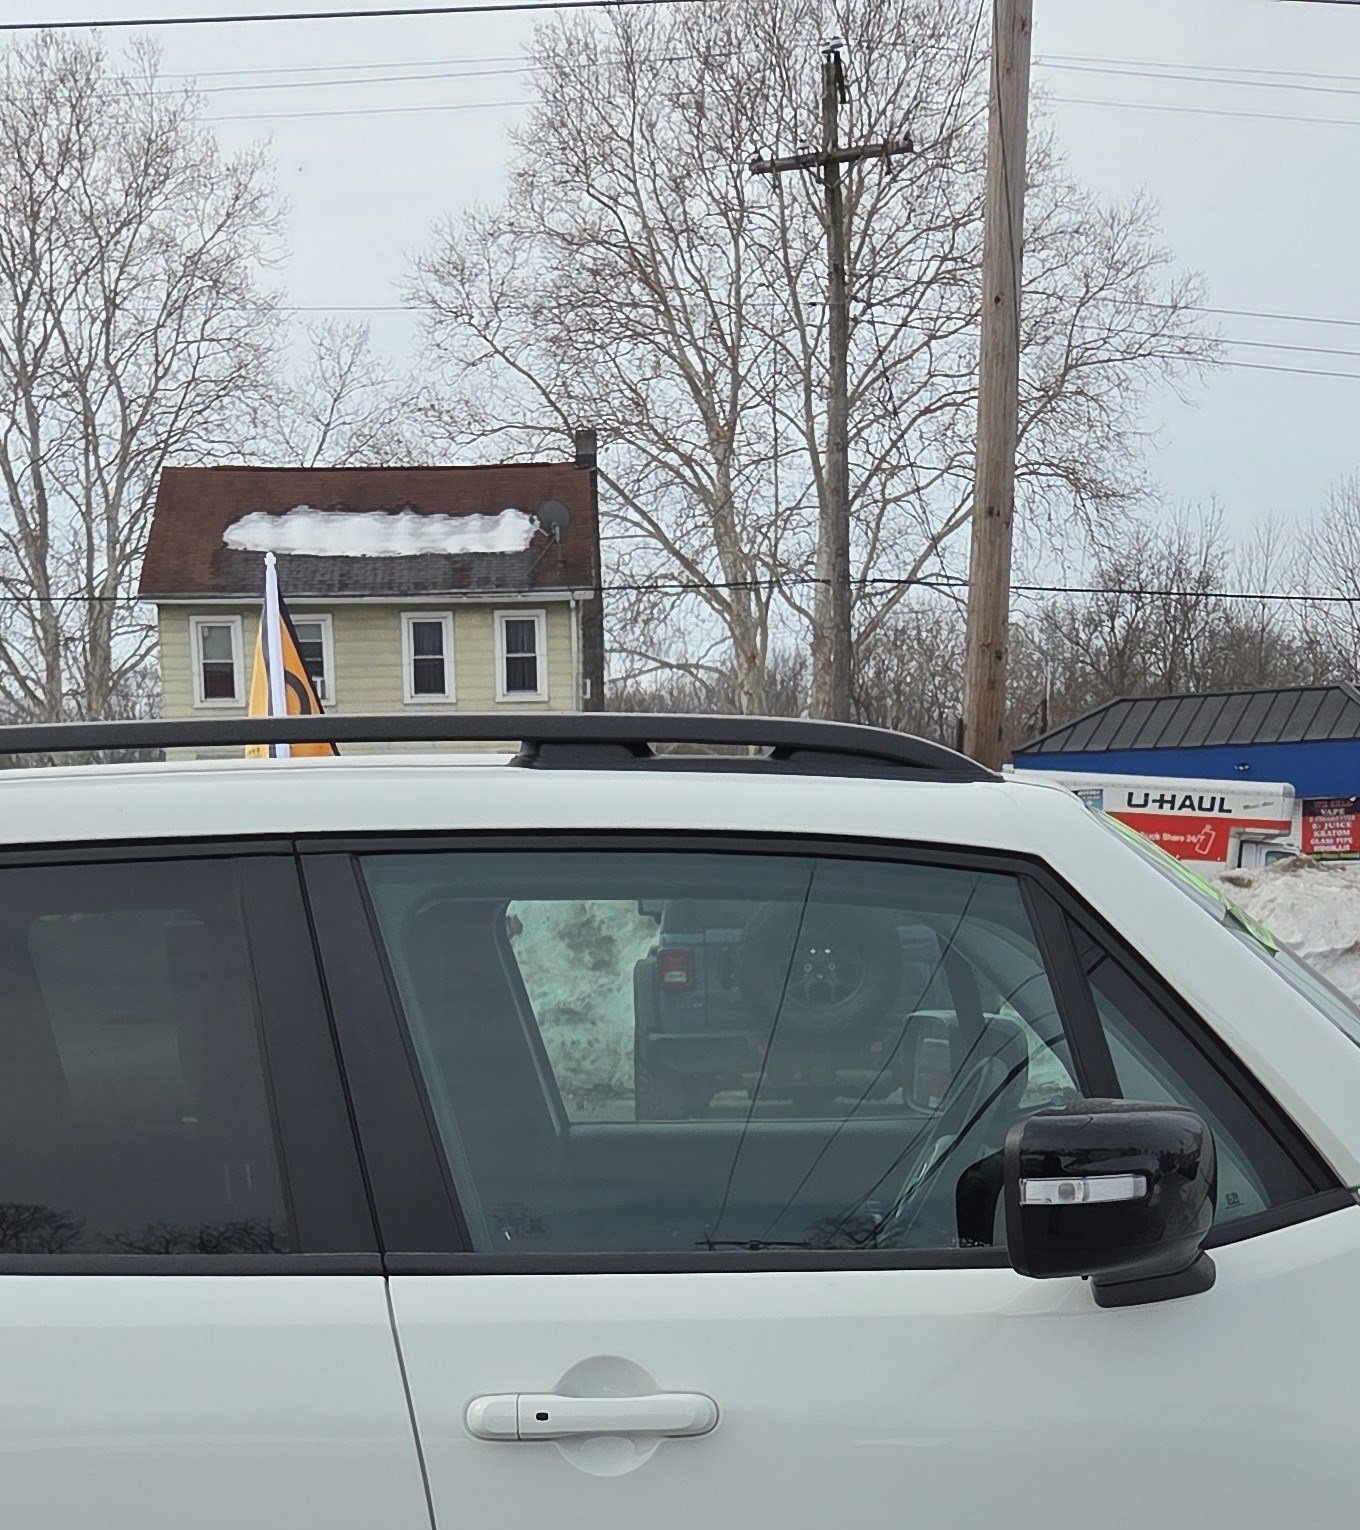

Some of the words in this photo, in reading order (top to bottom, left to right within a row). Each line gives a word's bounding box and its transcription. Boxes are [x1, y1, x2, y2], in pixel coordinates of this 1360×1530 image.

[1127, 791, 1232, 814] U-HAUL
[1323, 821, 1352, 830] JUICE
[1313, 829, 1351, 837] KRATOM
